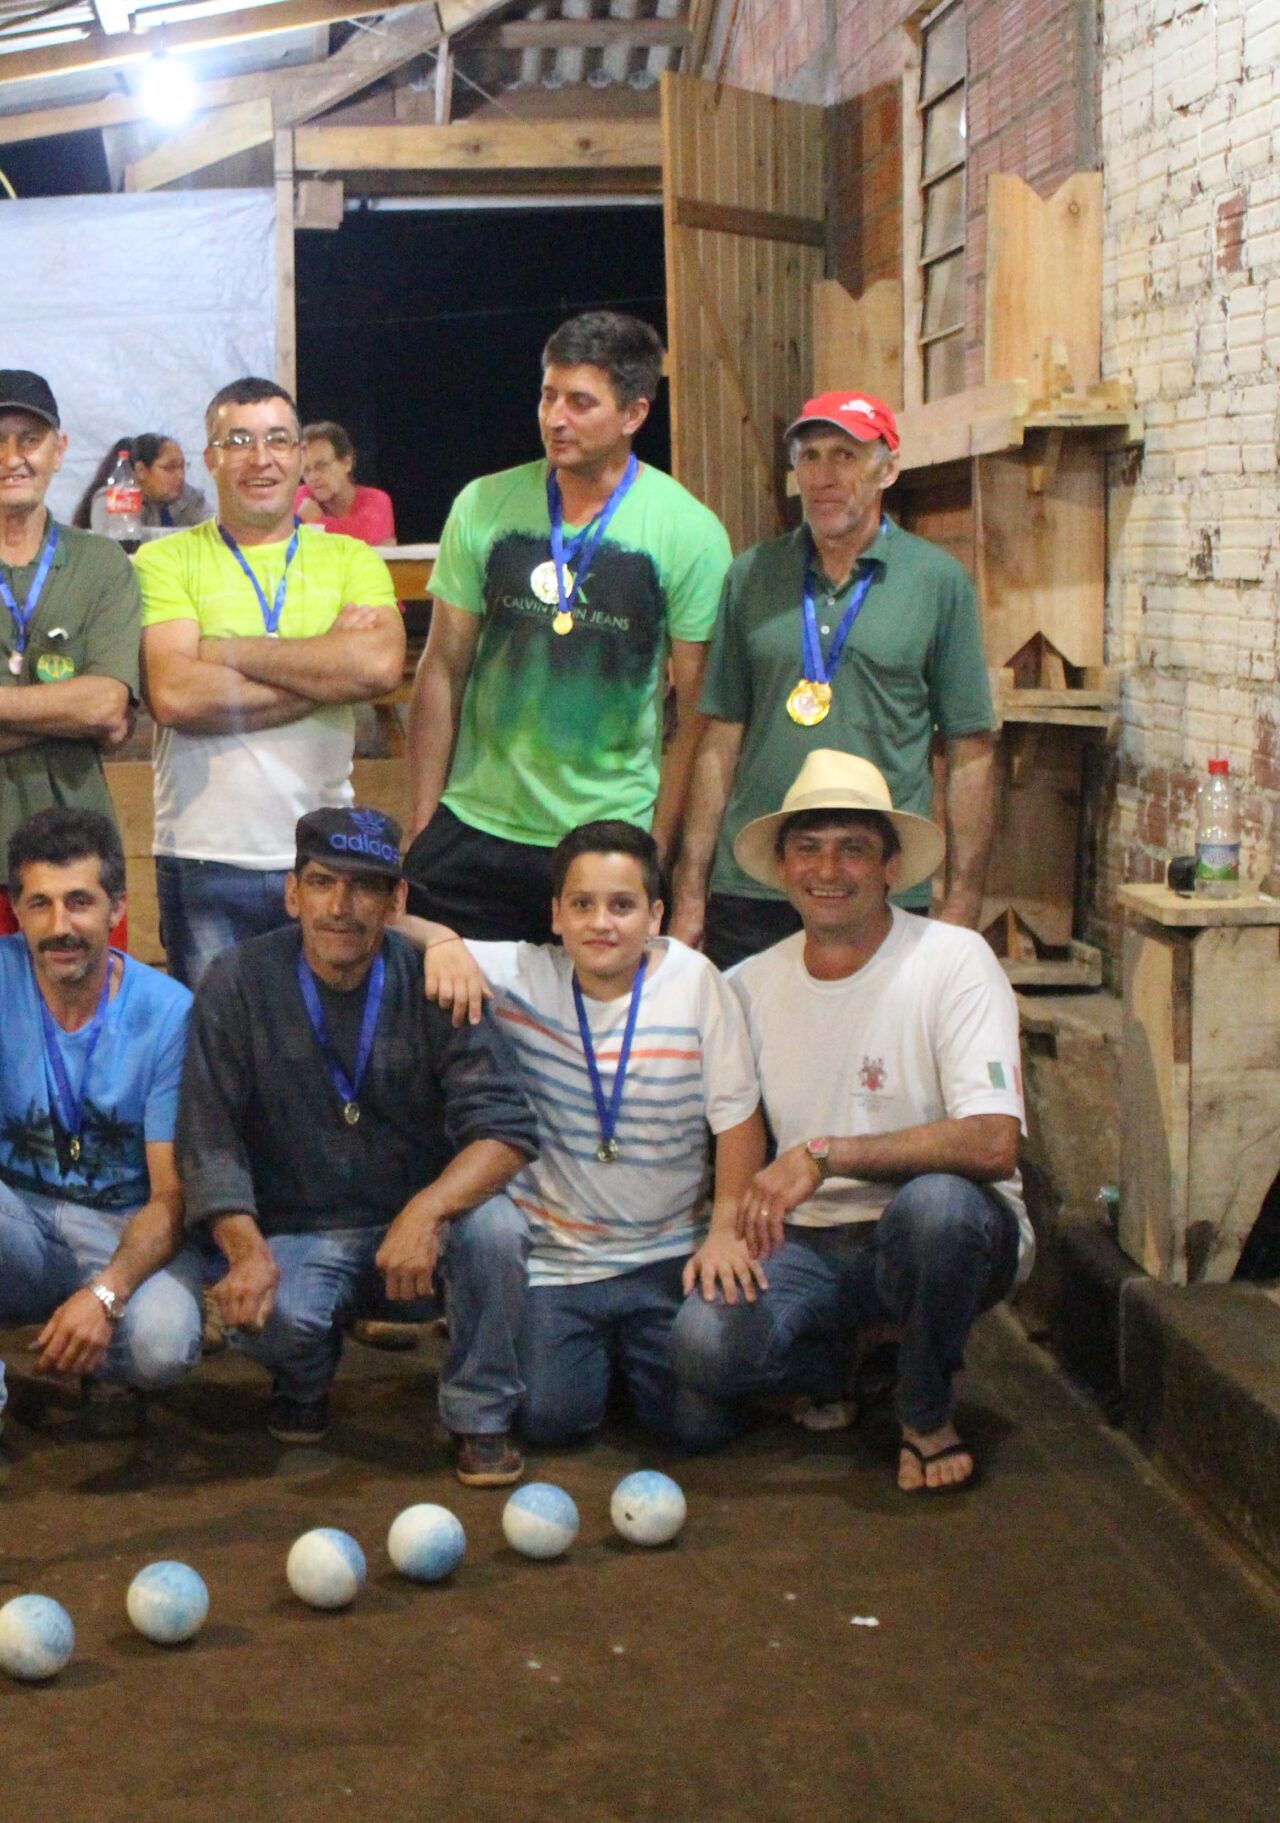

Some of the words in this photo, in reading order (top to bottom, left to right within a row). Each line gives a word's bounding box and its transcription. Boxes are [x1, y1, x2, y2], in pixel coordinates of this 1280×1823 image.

[503, 595, 549, 614] CALVIN
[551, 606, 587, 620] KIN
[590, 611, 630, 631] JEANS
[330, 834, 399, 864] adidas
